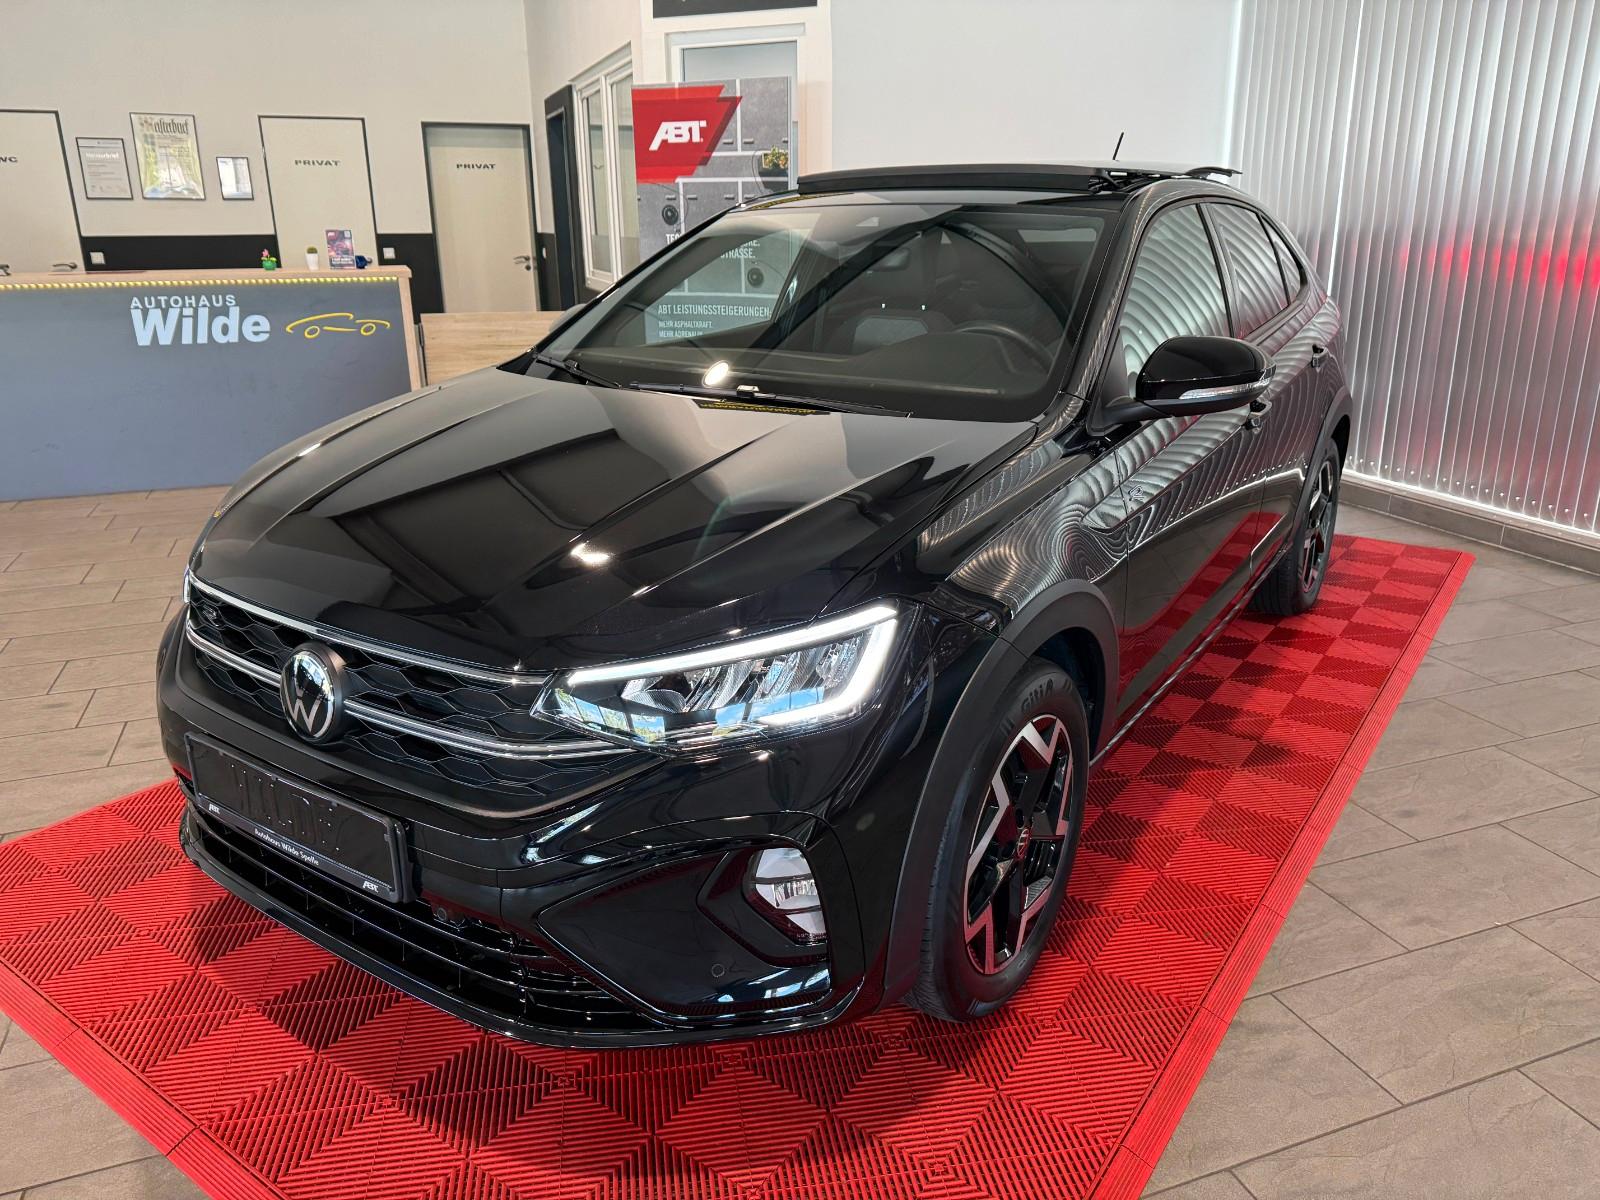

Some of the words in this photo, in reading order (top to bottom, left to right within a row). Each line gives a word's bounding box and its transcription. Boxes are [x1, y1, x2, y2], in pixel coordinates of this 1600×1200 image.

[648, 119, 707, 152] ABT
[294, 159, 341, 167] PRIVAT
[130, 294, 237, 309] AUTOHAUS
[657, 303, 672, 315] ABT
[130, 306, 271, 346] Wilde
[280, 842, 300, 856] Wilde
[362, 880, 379, 893] ABT
